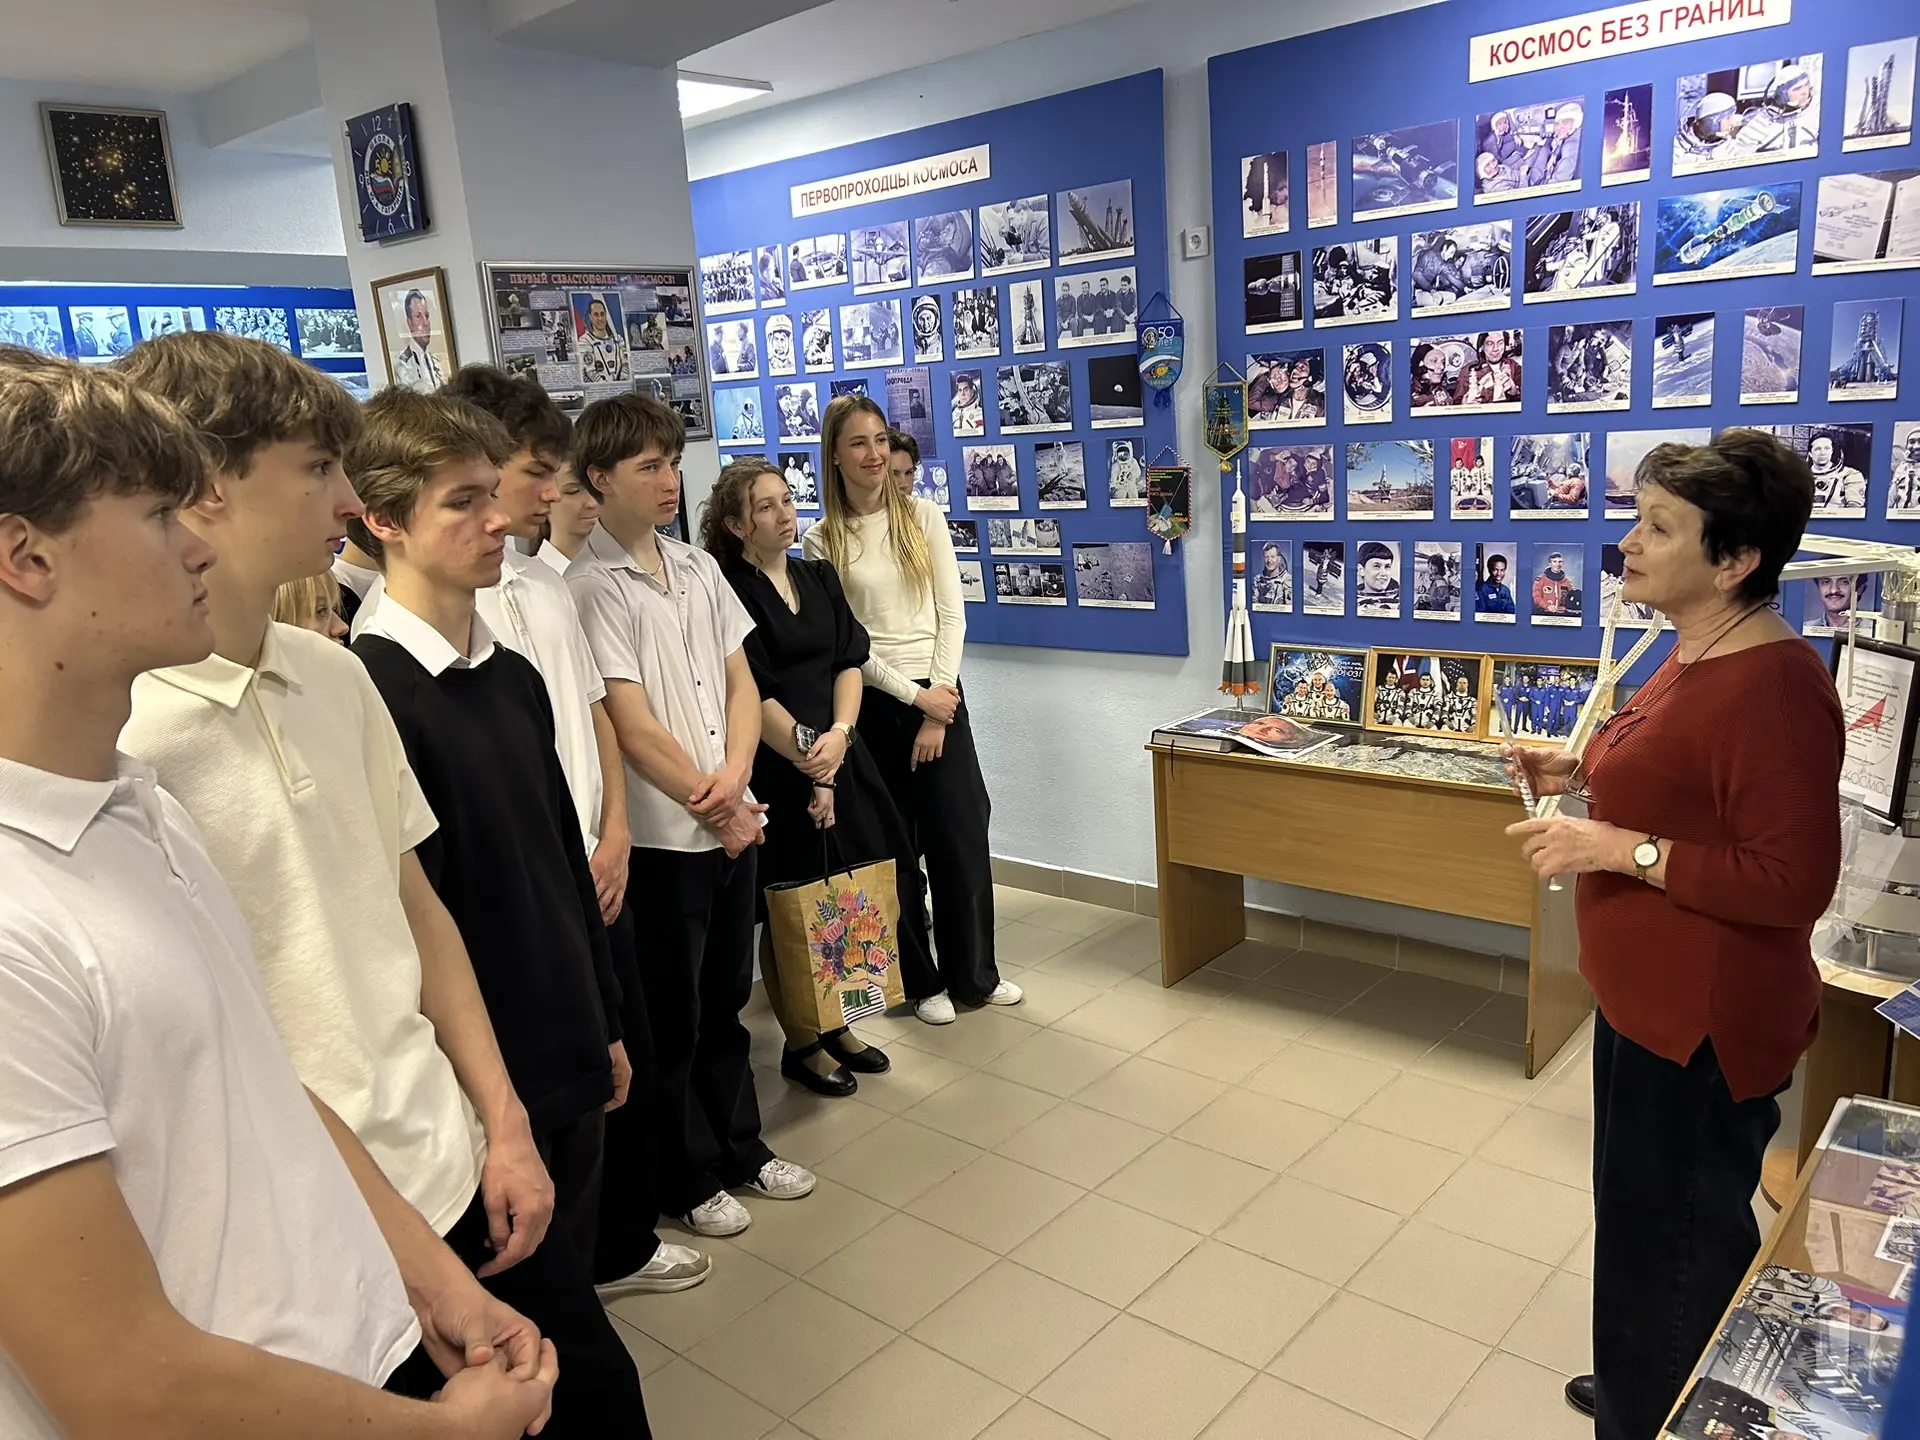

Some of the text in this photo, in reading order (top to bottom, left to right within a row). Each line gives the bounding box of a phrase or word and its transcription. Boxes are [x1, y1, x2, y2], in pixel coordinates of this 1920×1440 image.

[1489, 0, 1764, 67] КОСМОС БЕЗ ГРАНИЦ
[371, 115, 382, 132] 12
[358, 174, 365, 189] 9
[800, 156, 978, 208] ПЕРВОПРОХОДЦЫ КОСМОСА
[387, 218, 396, 235] 6
[509, 273, 549, 284] ПЕРВЫЙ
[1158, 325, 1175, 340] 50
